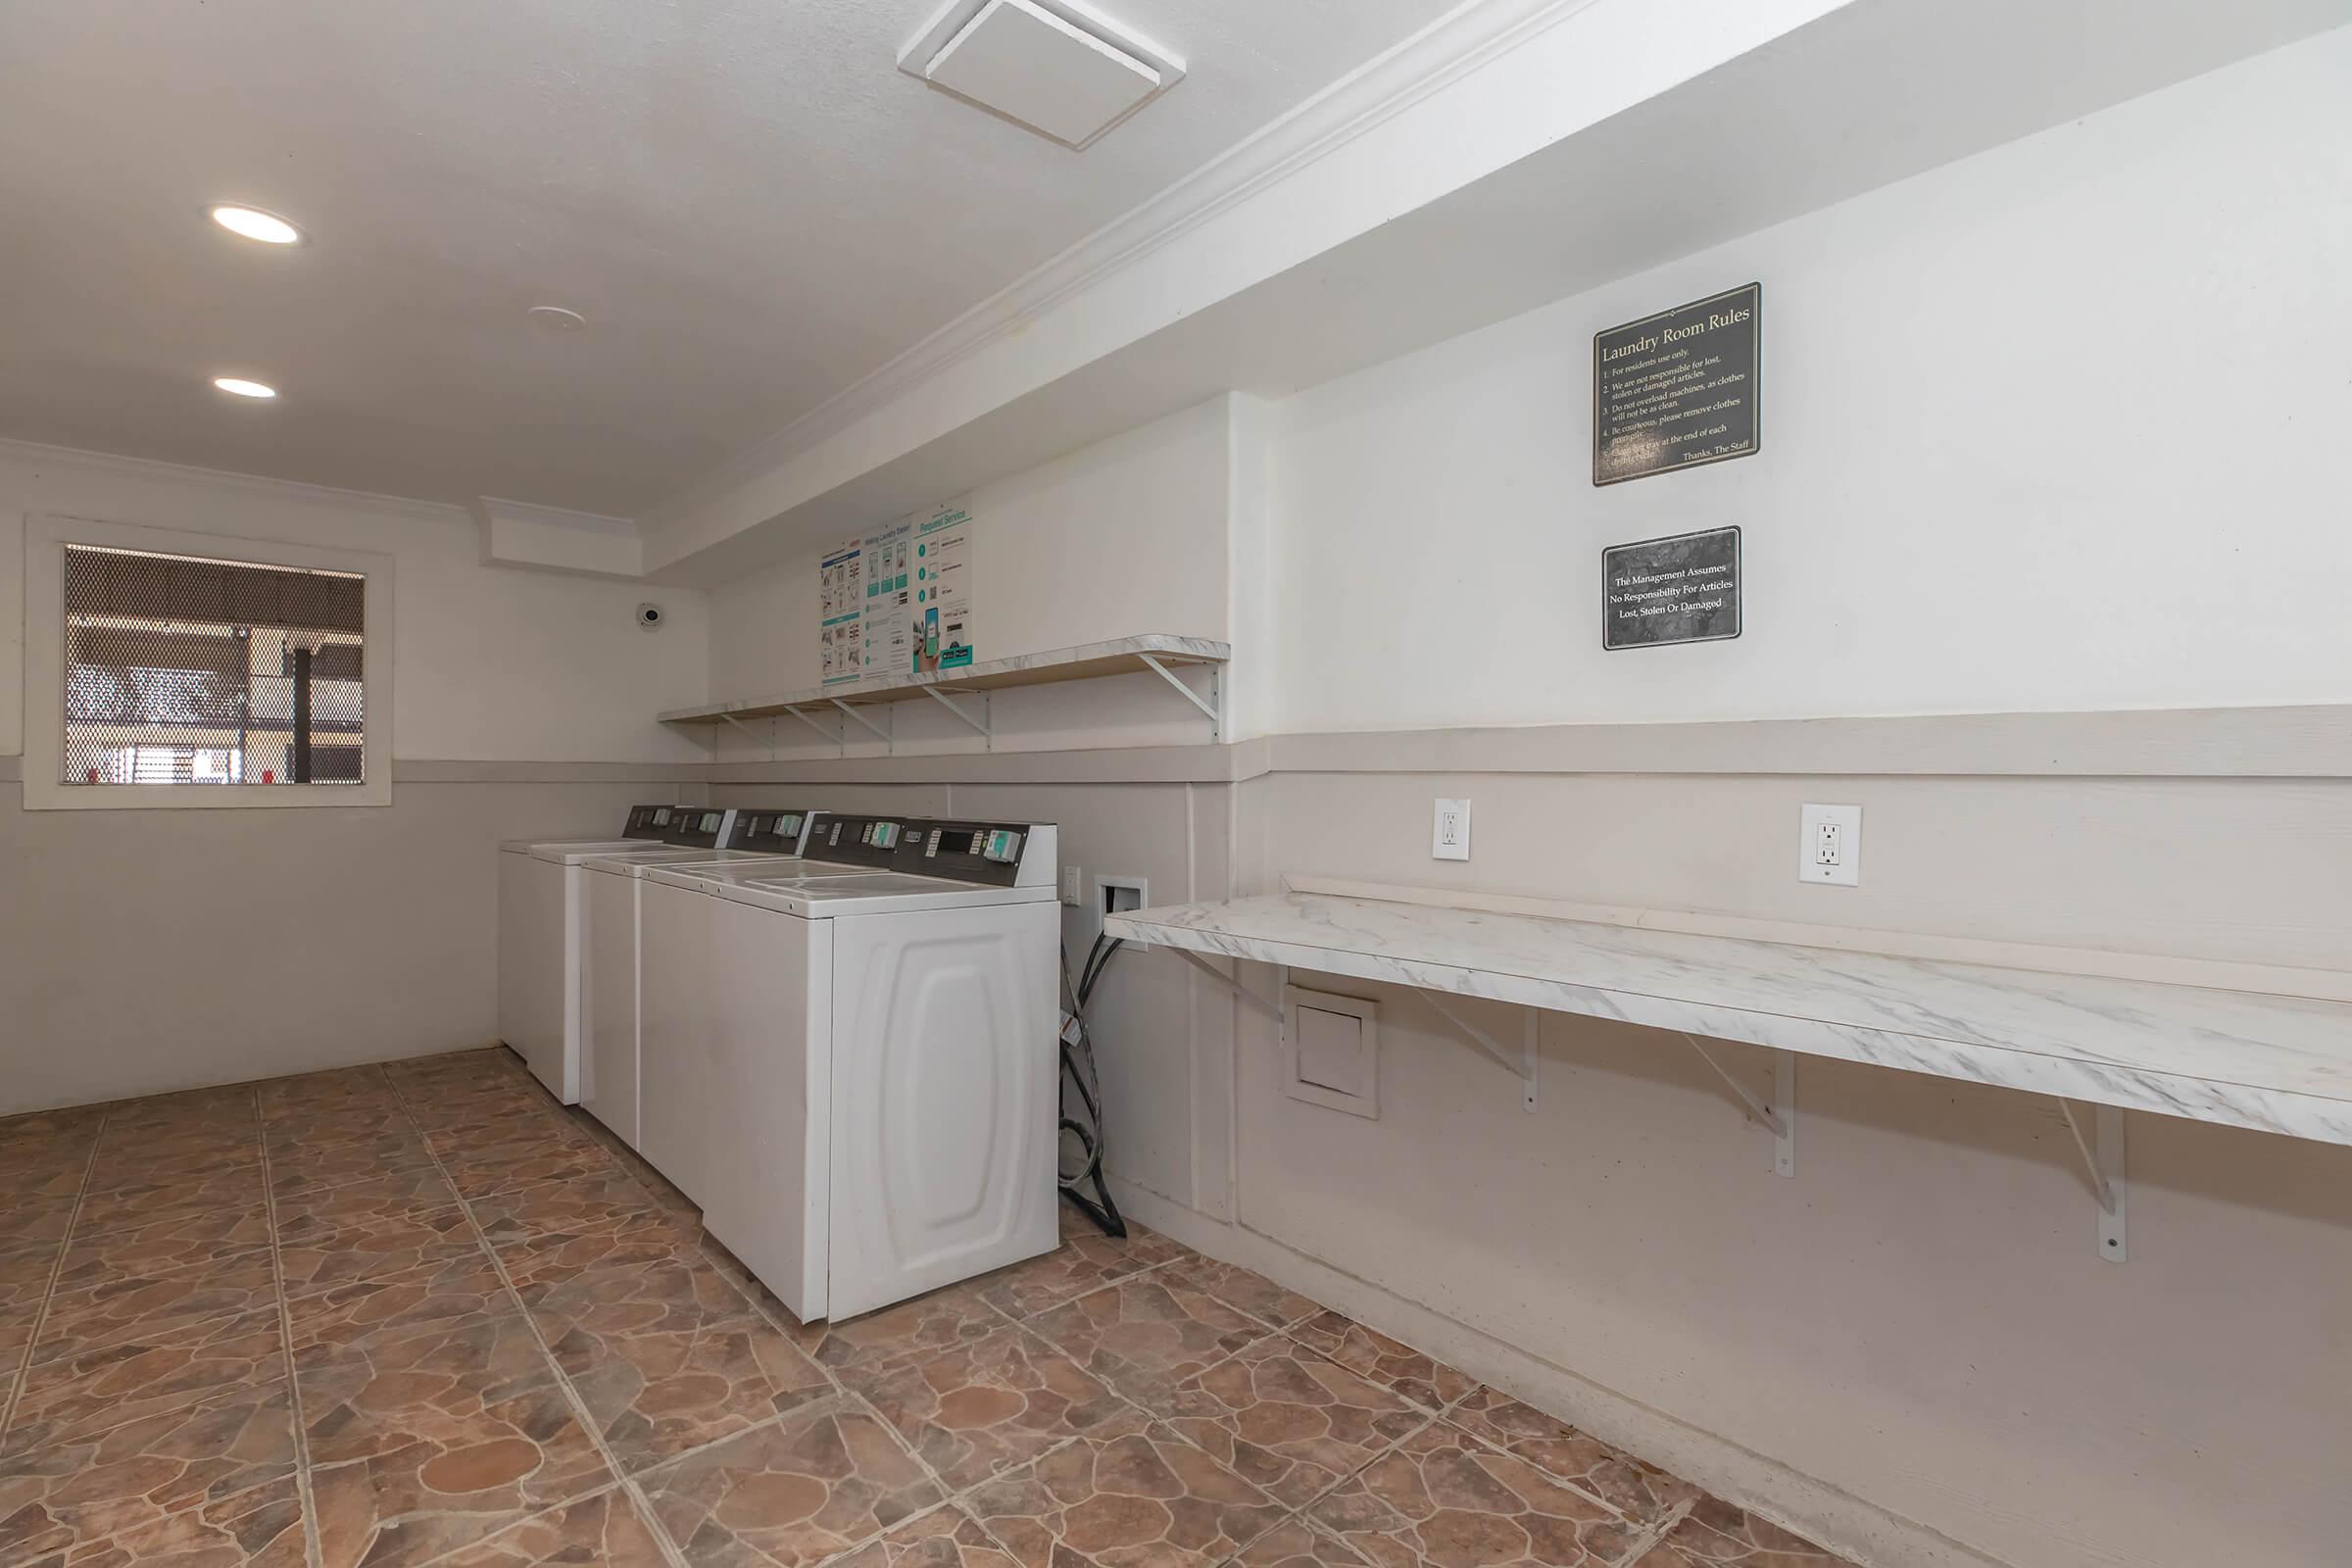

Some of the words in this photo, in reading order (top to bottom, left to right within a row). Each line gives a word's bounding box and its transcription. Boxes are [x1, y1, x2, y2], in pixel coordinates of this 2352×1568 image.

[1603, 336, 1659, 362] Laundry
[1663, 321, 1705, 344] Room
[1709, 309, 1750, 330] Rules
[1612, 367, 1624, 376] For
[1625, 359, 1656, 372] residents
[1657, 355, 1670, 364] use
[1612, 382, 1623, 391] We
[1624, 379, 1635, 388] are
[1636, 375, 1648, 384] not
[1649, 364, 1690, 381] responsible
[1691, 360, 1703, 369] for
[1612, 390, 1633, 400] stolen
[1642, 375, 1676, 389] damaged
[1612, 405, 1622, 414] Do
[1624, 401, 1635, 410] not
[1636, 392, 1668, 407] overload
[1669, 383, 1705, 398] machines,
[1717, 373, 1744, 385] clothes
[1612, 411, 1625, 421] will
[1627, 409, 1638, 418] not
[1612, 426, 1622, 435] Be
[1659, 413, 1682, 425] please
[1684, 405, 1712, 417] remove
[1712, 398, 1740, 411] clothes
[1661, 437, 1669, 446] at
[1670, 434, 1682, 444] the
[1684, 429, 1697, 440] end
[1699, 428, 1708, 437] of
[1709, 423, 1727, 435] each
[1683, 448, 1712, 461] Thanks,
[1714, 444, 1729, 455] The
[1731, 438, 1749, 451] Staff
[919, 519, 944, 533] Request
[944, 510, 966, 525] Service
[1615, 577, 1631, 587] The
[1632, 570, 1685, 584] Management
[1687, 564, 1726, 576] Assumes
[1610, 595, 1622, 604] No
[1624, 588, 1681, 603] Responsibility
[1683, 584, 1697, 594] For
[1699, 580, 1733, 592] Articles
[1619, 610, 1639, 618] Lost,
[1641, 606, 1665, 616] Stolen
[1667, 604, 1679, 612] Or
[1680, 598, 1722, 611] Damaged
